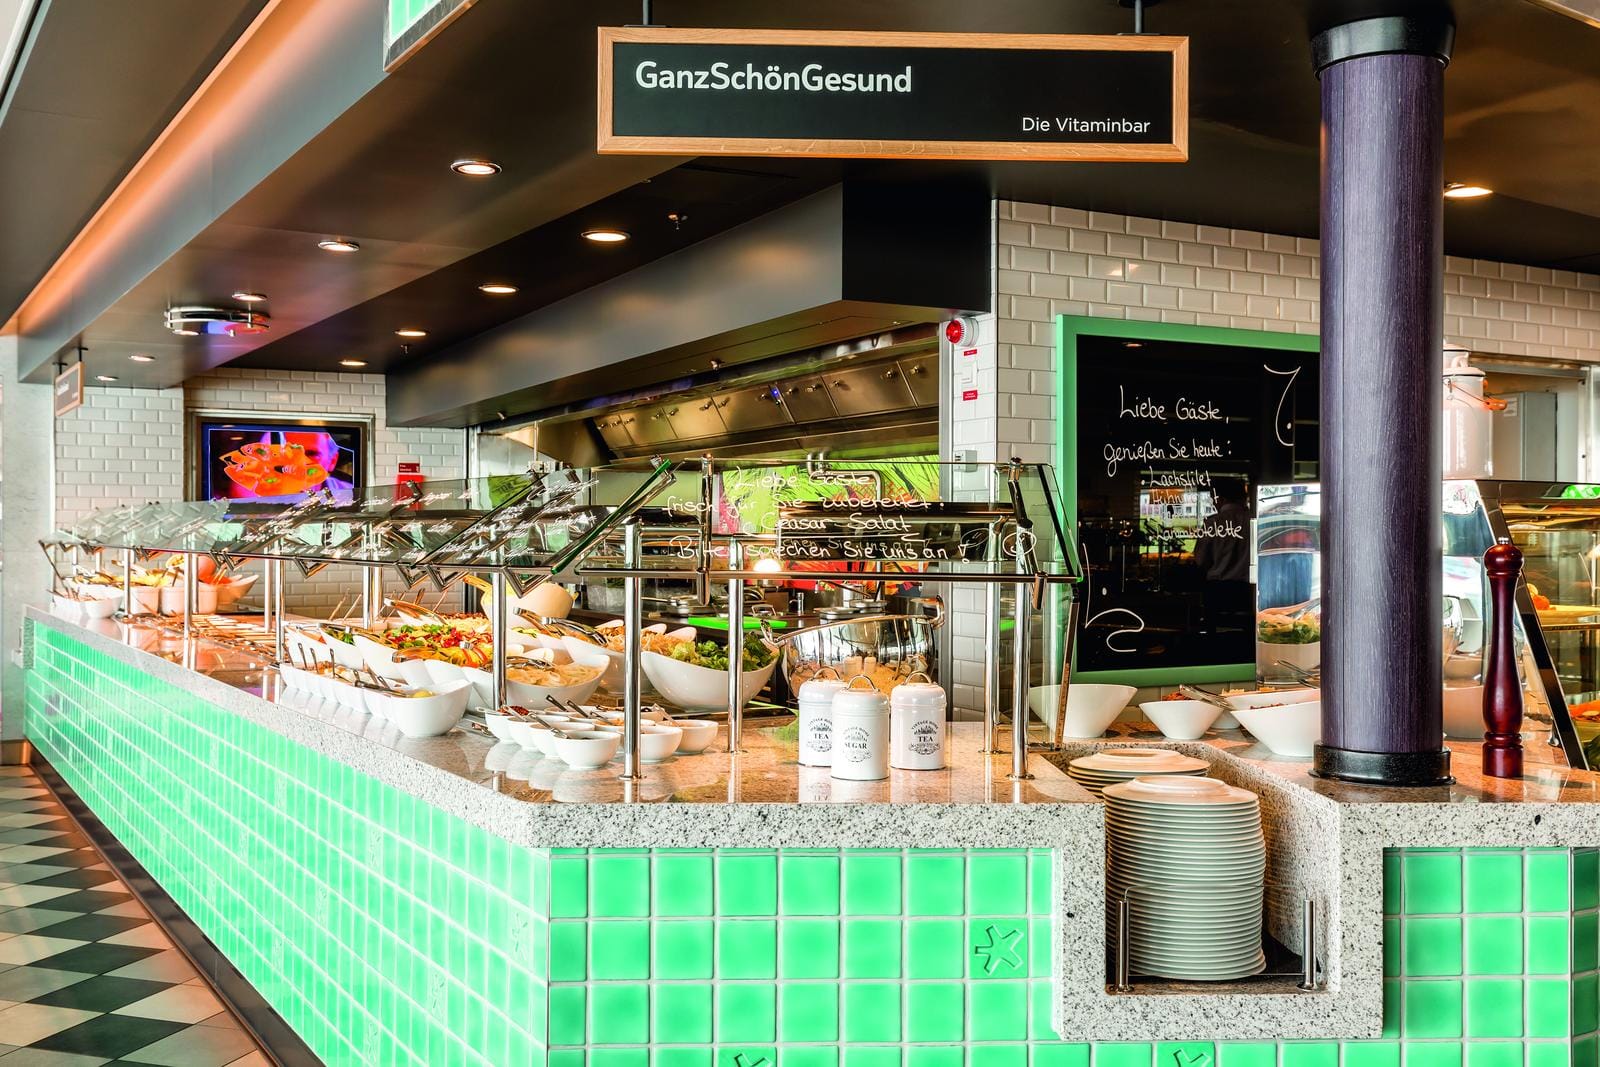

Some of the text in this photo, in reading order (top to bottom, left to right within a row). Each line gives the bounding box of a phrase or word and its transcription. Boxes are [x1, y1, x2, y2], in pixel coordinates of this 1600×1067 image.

[635, 60, 912, 93] GanzSchönGesund
[1022, 117, 1151, 132] Die Vitaminbar
[1119, 385, 1229, 424] Liebe Gäste,
[1103, 440, 1165, 477] genießen
[1168, 437, 1190, 459] Sie
[735, 466, 798, 490] Liebe
[661, 495, 719, 517] frisch
[771, 494, 807, 509] Sie
[669, 535, 730, 559] Bitte
[843, 540, 874, 558] Sie
[881, 548, 918, 560] uns
